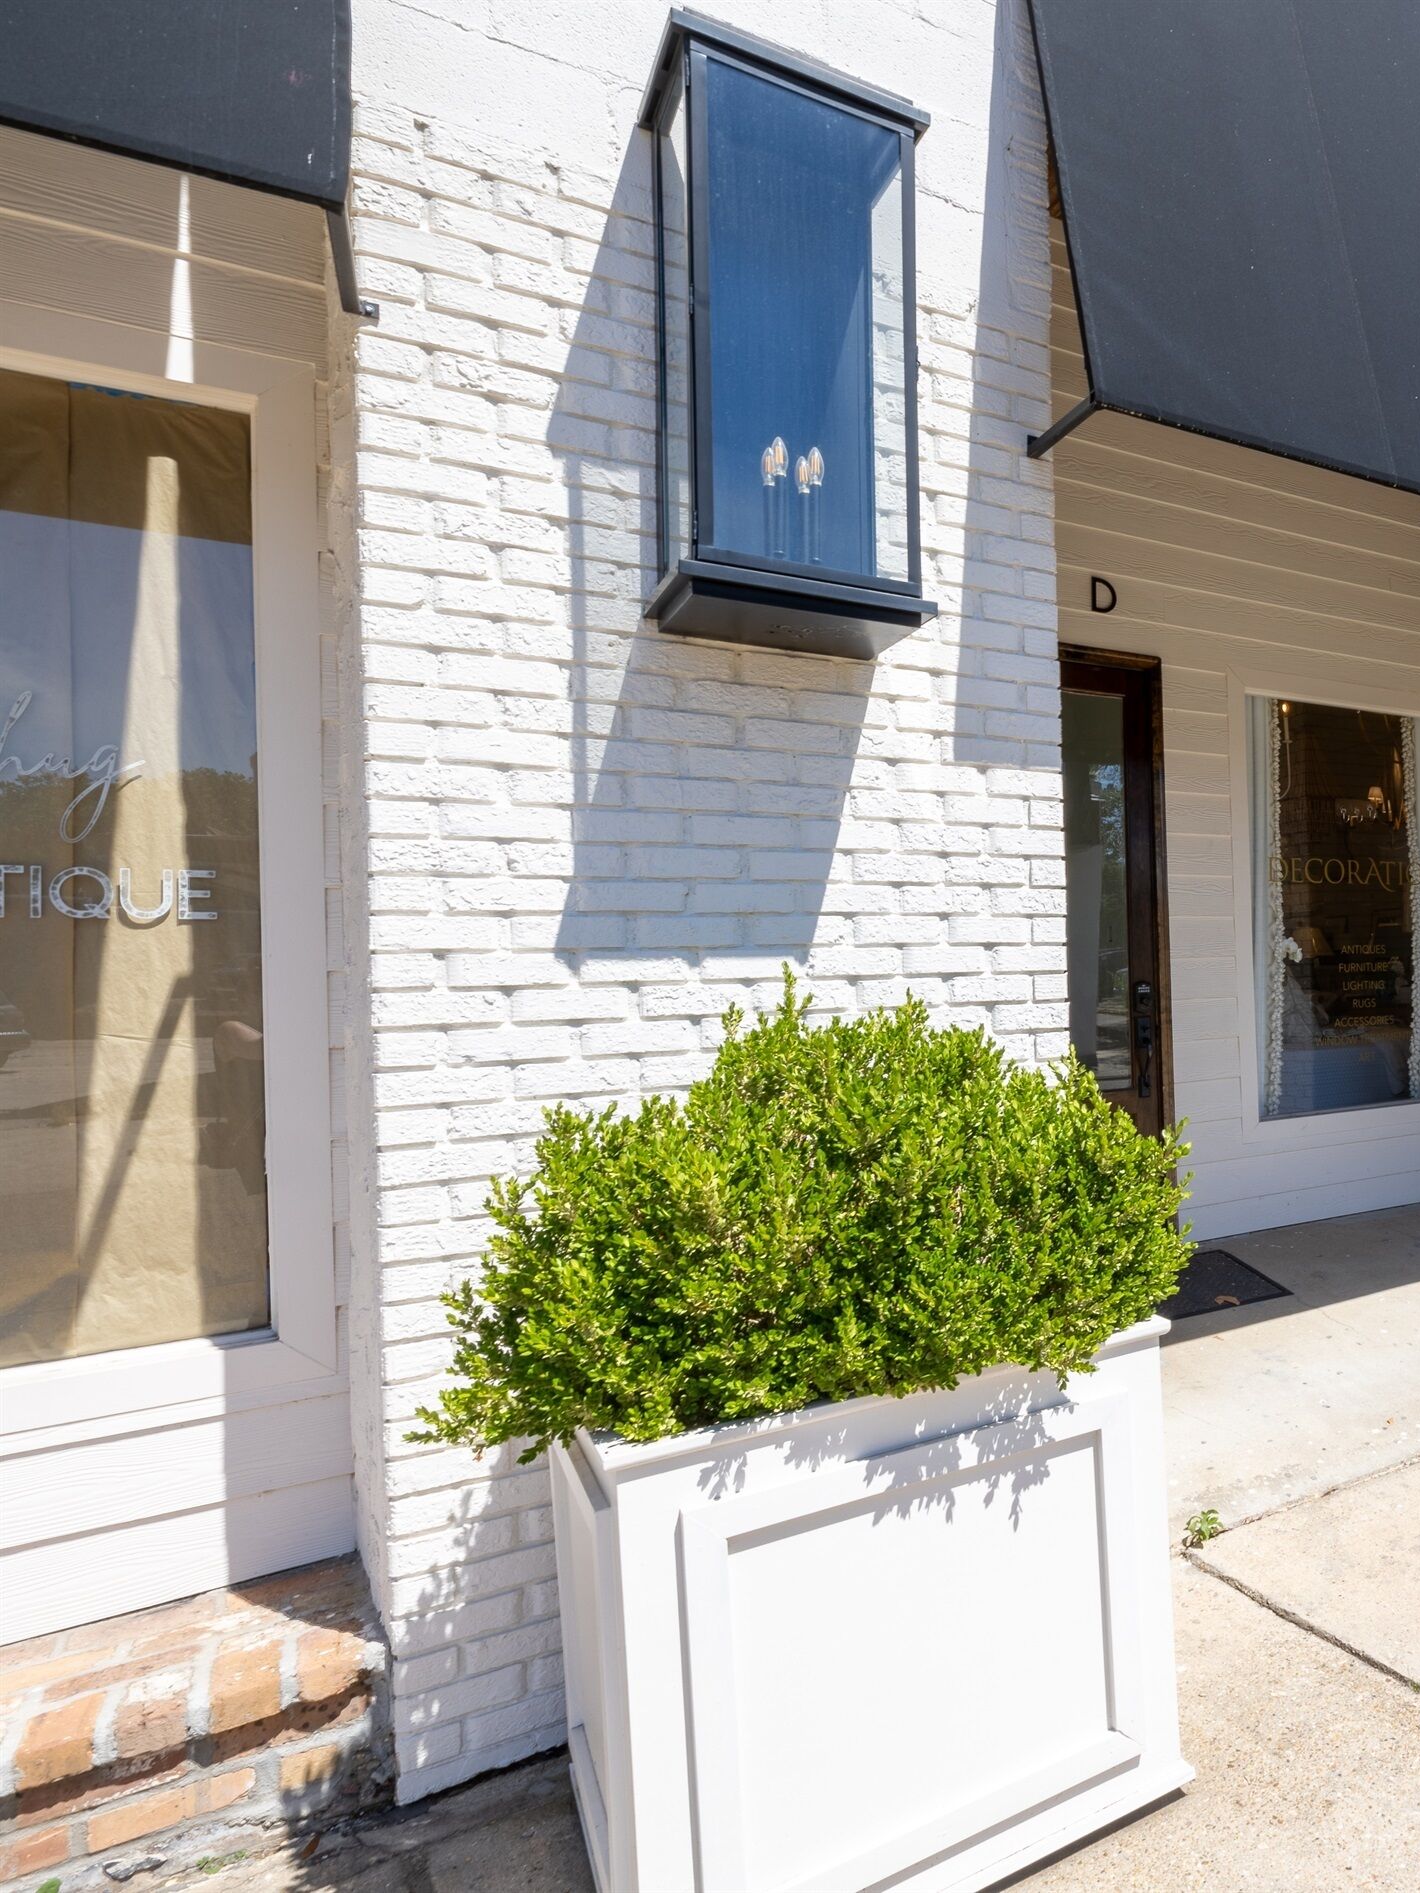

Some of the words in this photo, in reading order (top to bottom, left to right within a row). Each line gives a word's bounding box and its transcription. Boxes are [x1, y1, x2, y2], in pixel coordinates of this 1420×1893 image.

[1091, 576, 1117, 613] D
[1341, 944, 1387, 955] ANTIQUES
[1338, 962, 1389, 973] FURNITURE
[1342, 980, 1385, 991] LIGHTING
[1352, 998, 1377, 1008] RUGS
[1334, 1015, 1394, 1028] ACCESSORIES
